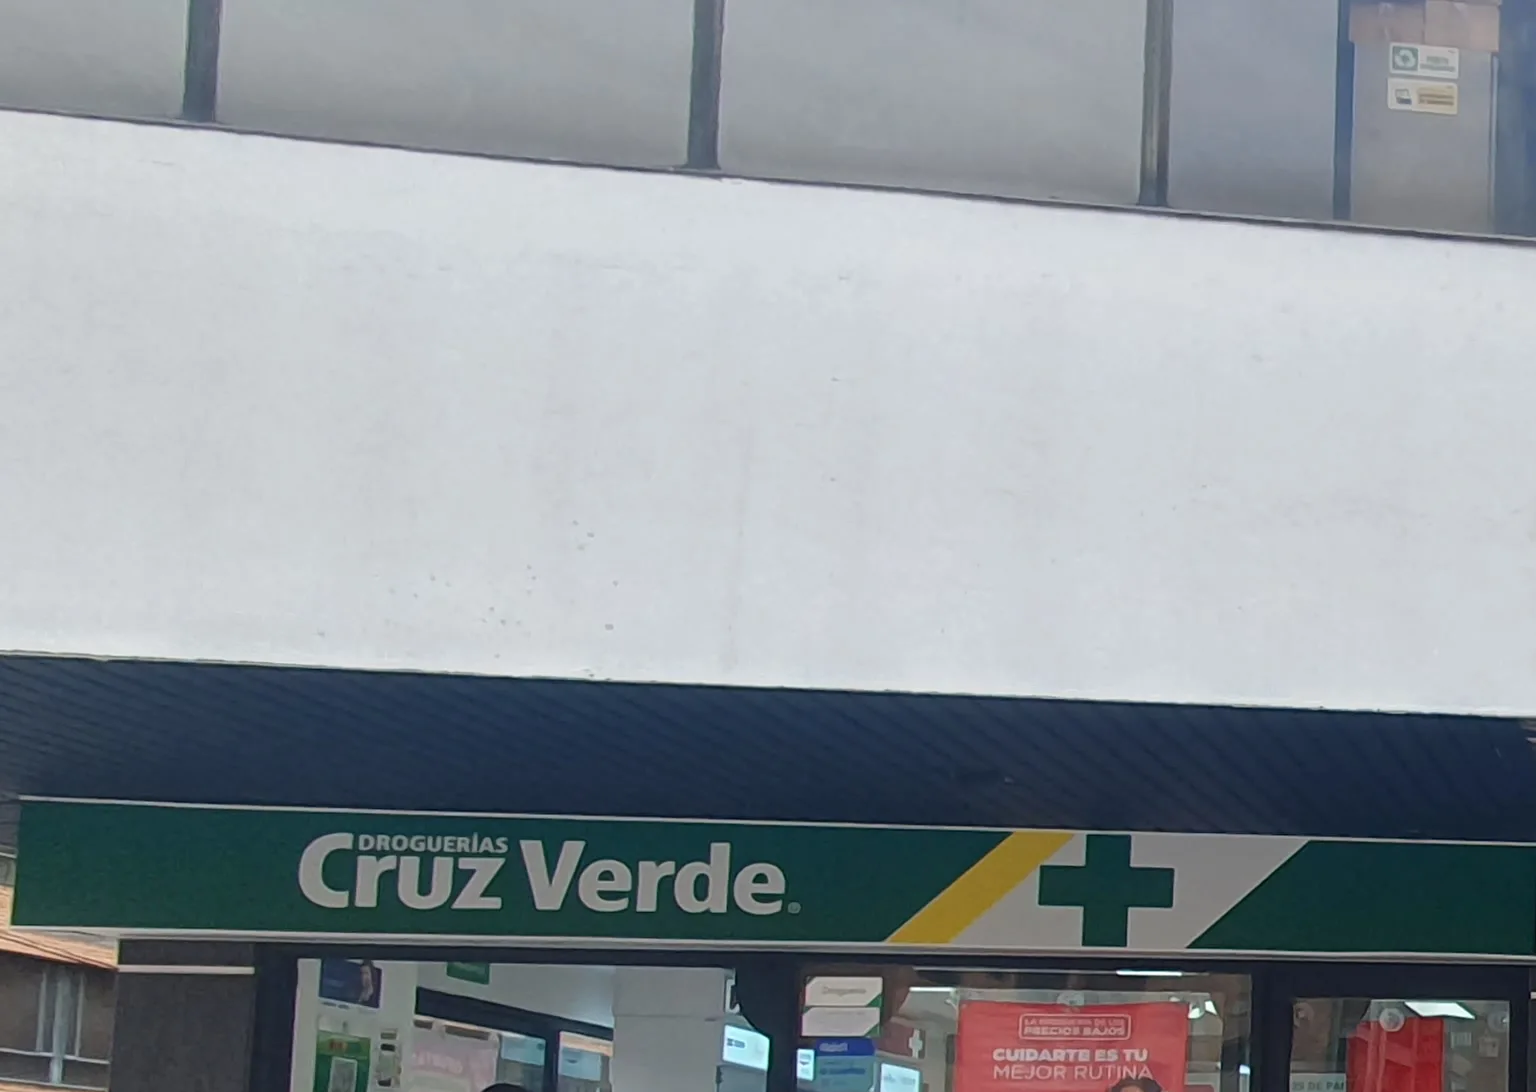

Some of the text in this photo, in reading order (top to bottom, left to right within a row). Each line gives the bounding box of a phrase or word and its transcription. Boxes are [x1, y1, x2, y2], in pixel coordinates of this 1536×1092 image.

[358, 832, 508, 854] DROGUERÍAS
[299, 832, 786, 915] Cruz Verde
[992, 1048, 1149, 1063] CUIDARTE ES TU
[993, 1064, 1153, 1080] MEJOR RUTINA
